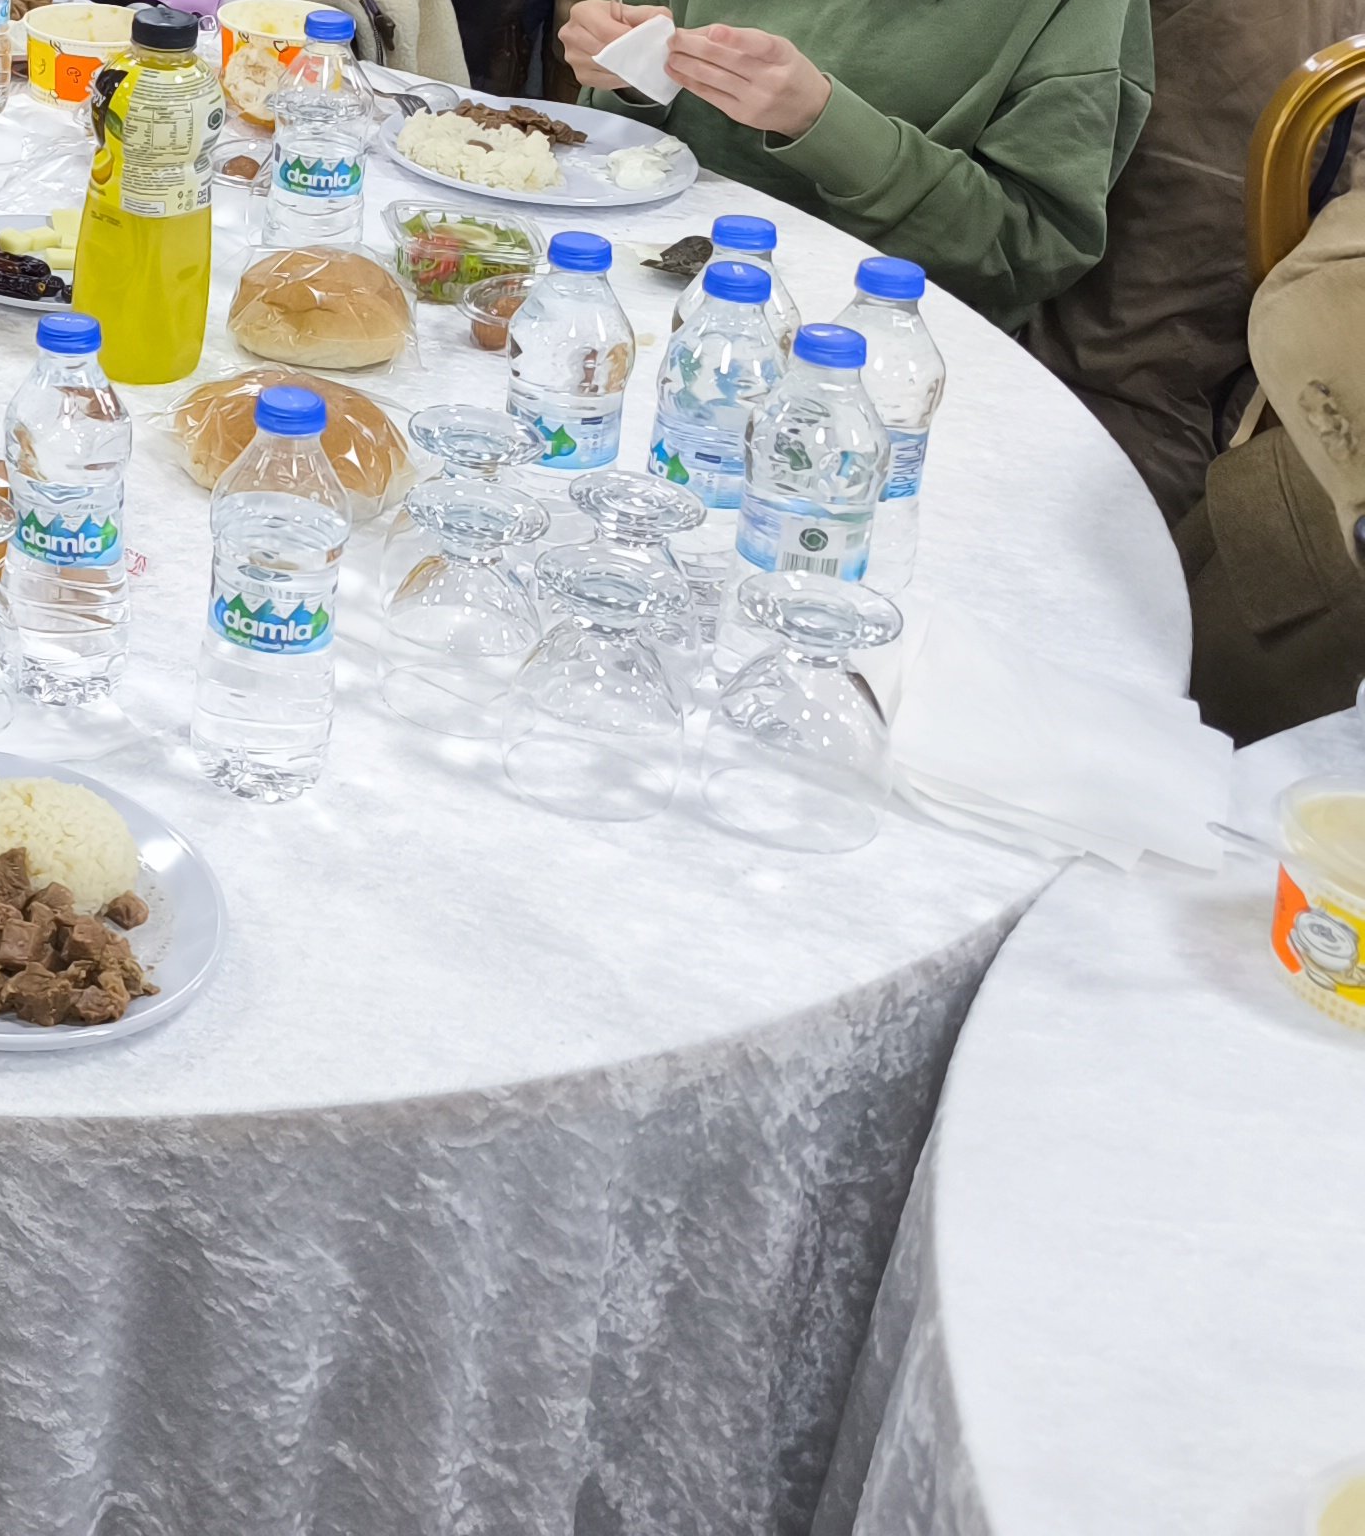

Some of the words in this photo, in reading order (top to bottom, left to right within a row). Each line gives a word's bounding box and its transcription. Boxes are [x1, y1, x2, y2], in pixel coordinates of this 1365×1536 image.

[286, 167, 351, 188] damla
[20, 524, 106, 554] damla
[222, 608, 313, 642] damla
